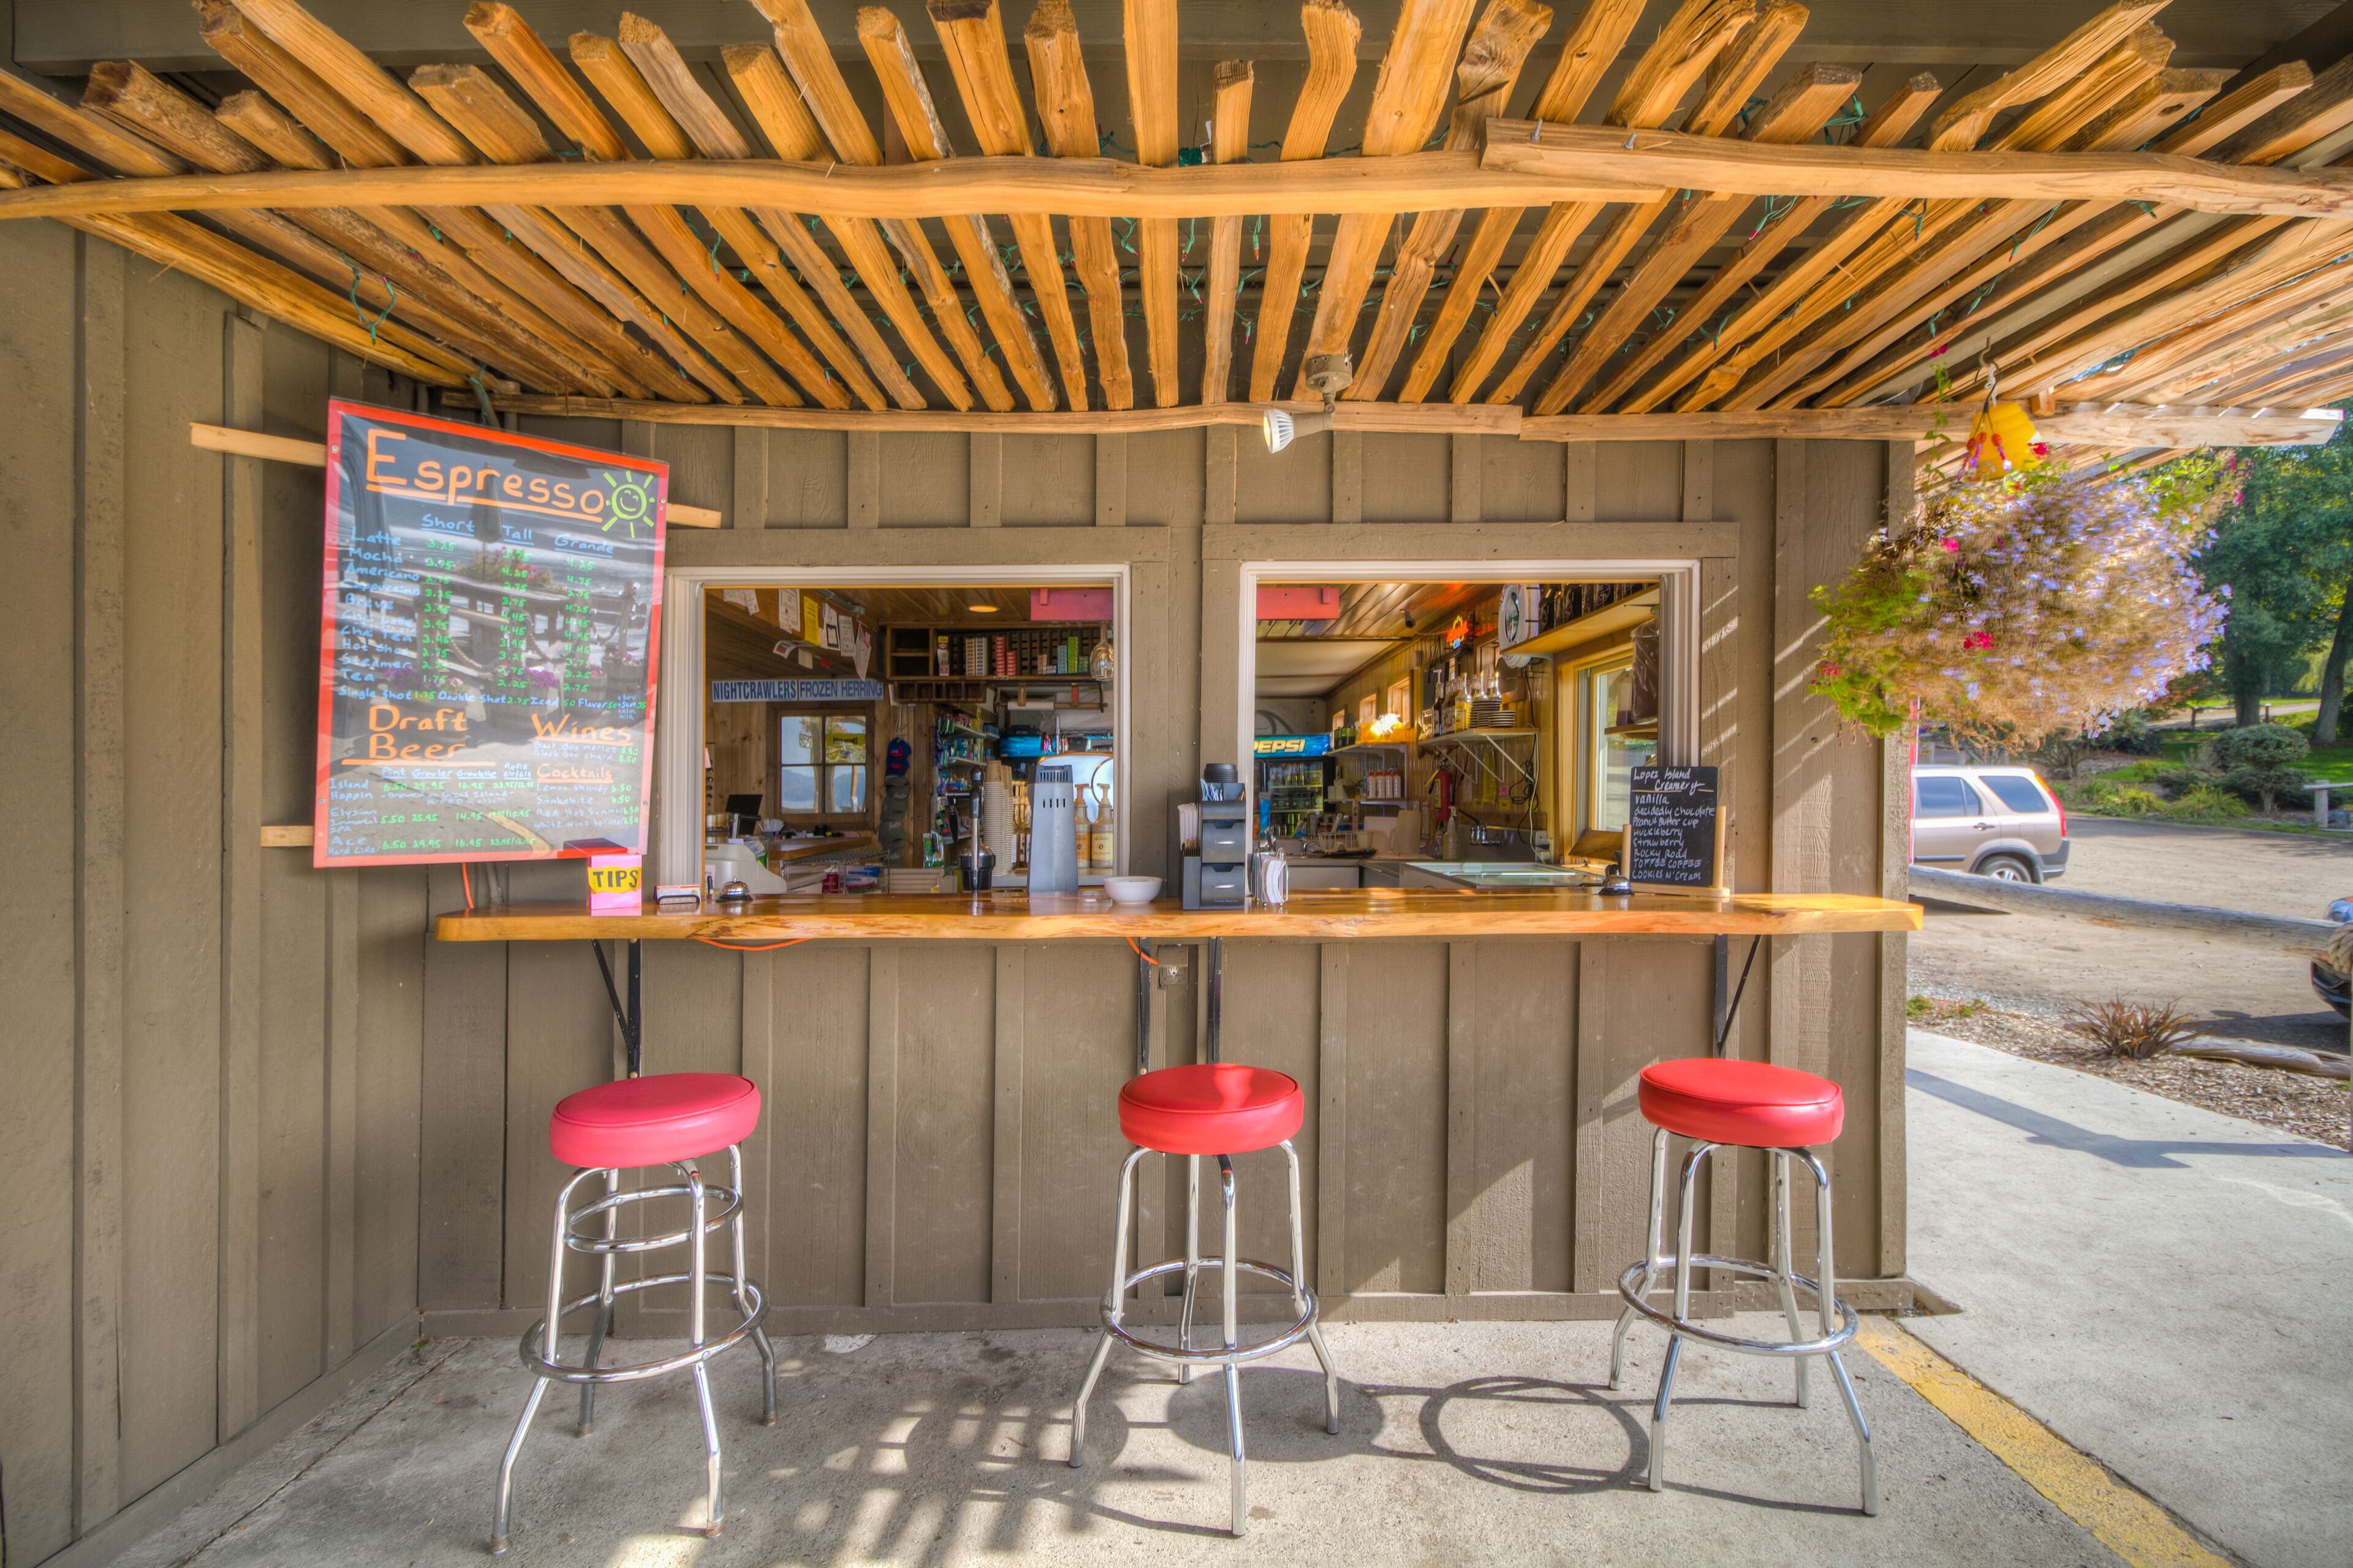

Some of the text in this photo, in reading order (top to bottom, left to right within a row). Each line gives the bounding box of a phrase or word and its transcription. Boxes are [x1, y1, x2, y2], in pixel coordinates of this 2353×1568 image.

[366, 428, 605, 514] Espresso
[421, 513, 614, 553] Short Tall Grande
[350, 526, 401, 546] Latte
[567, 558, 596, 570] 4.25
[347, 562, 420, 581] Americano
[349, 547, 403, 564] Mocha
[567, 575, 592, 586] 4.75
[345, 593, 394, 610] Breve
[341, 625, 373, 638] Chai
[382, 631, 413, 643] Tea
[342, 638, 368, 651] Hot
[342, 653, 411, 668] Steamer
[341, 668, 376, 682] Tea
[338, 684, 376, 700] Single
[438, 691, 476, 702] Double
[530, 697, 559, 707] Iced
[713, 681, 883, 700] NIGHTCRAWLERS FROZEN HERRING
[369, 705, 469, 732] Draft
[531, 713, 632, 742] Wines
[369, 733, 466, 760] Beer
[382, 767, 407, 776] Pint
[412, 768, 452, 777] Growler
[537, 762, 612, 779] Cocktails
[1634, 767, 1691, 784] Lopez Island
[330, 778, 369, 789] Island
[1654, 780, 1705, 796] Creamery
[330, 808, 377, 819] Elysian
[1634, 805, 1673, 820] decidedly
[1632, 817, 1658, 827] Peanut
[331, 836, 366, 846] Ace
[1634, 858, 1666, 868] TOFFEE
[593, 870, 638, 888] TIPS
